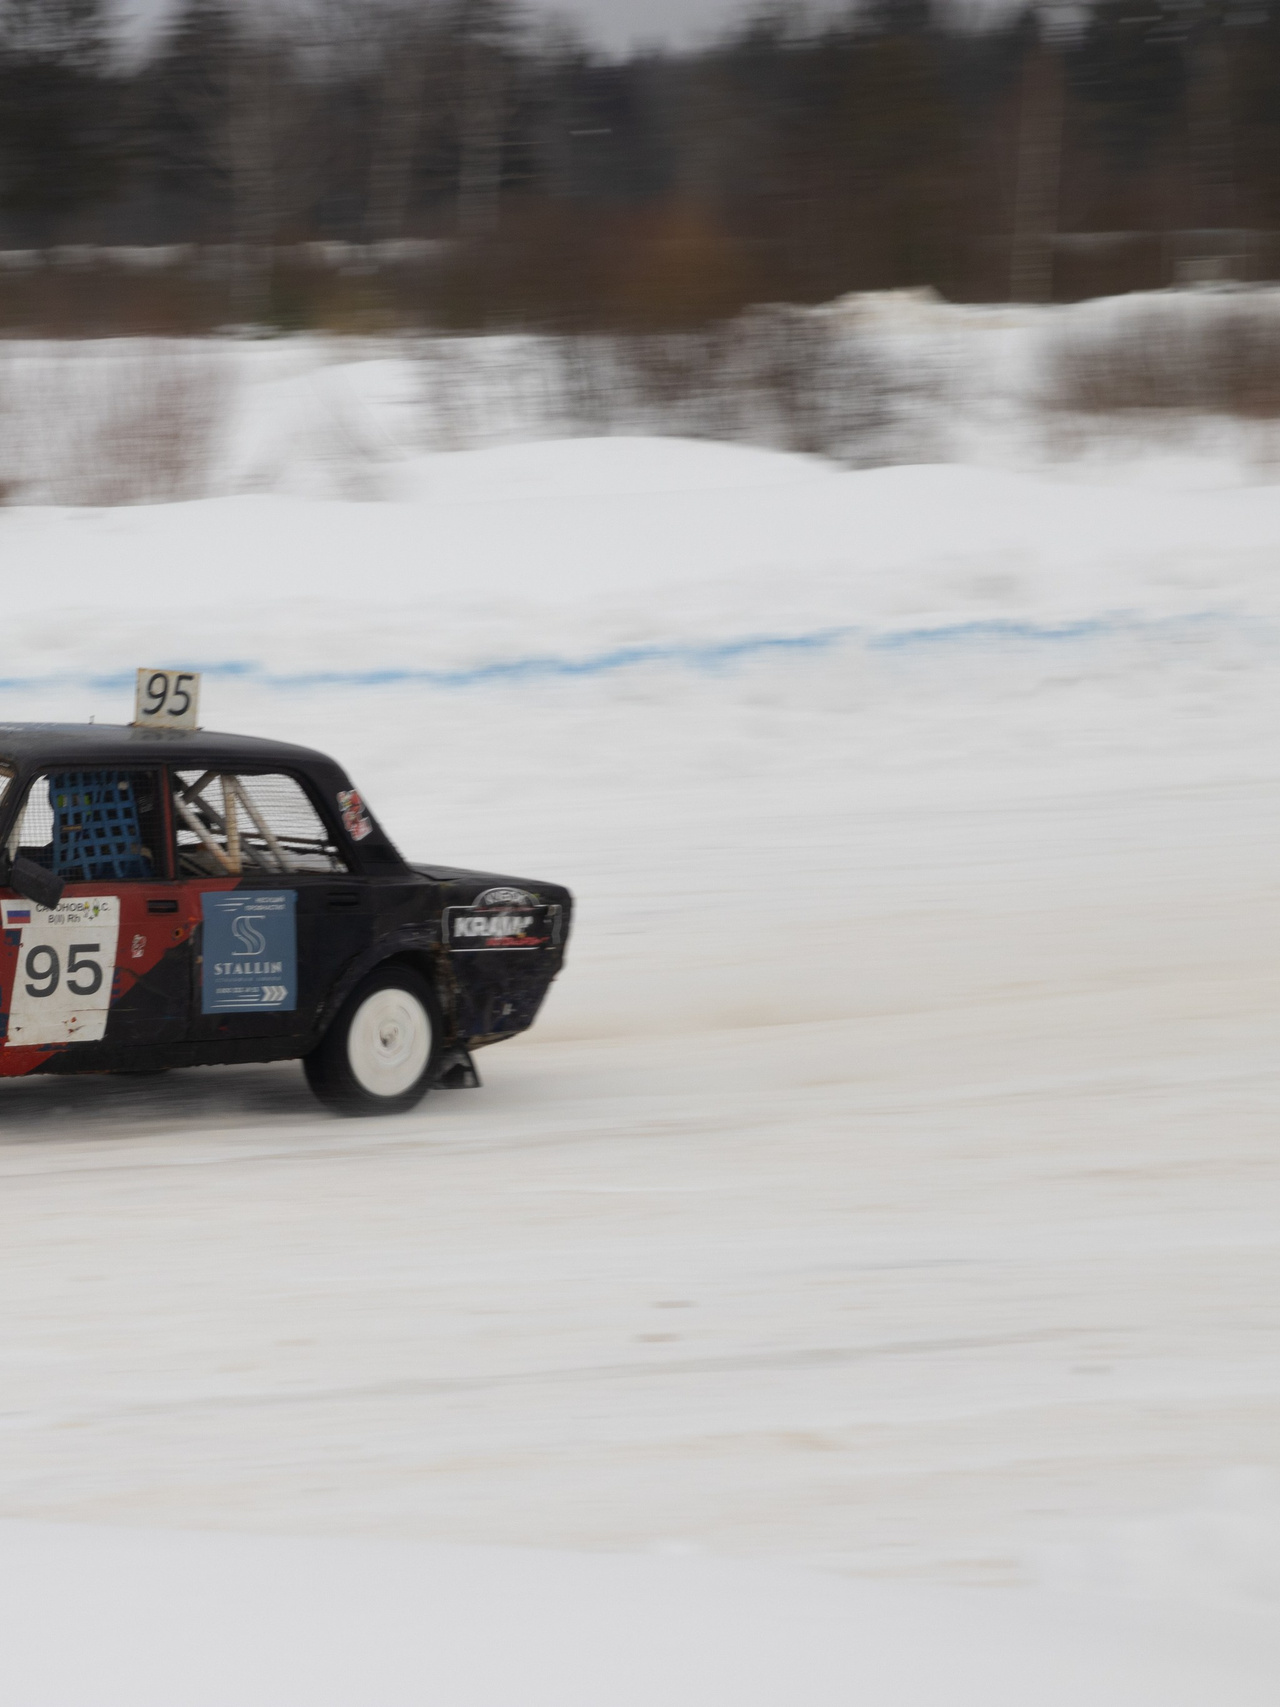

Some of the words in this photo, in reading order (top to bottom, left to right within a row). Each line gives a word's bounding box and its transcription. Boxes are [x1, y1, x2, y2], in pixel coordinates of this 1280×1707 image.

[142, 672, 195, 716] 95
[25, 943, 103, 998] 95
[213, 961, 283, 976] STALLIN
